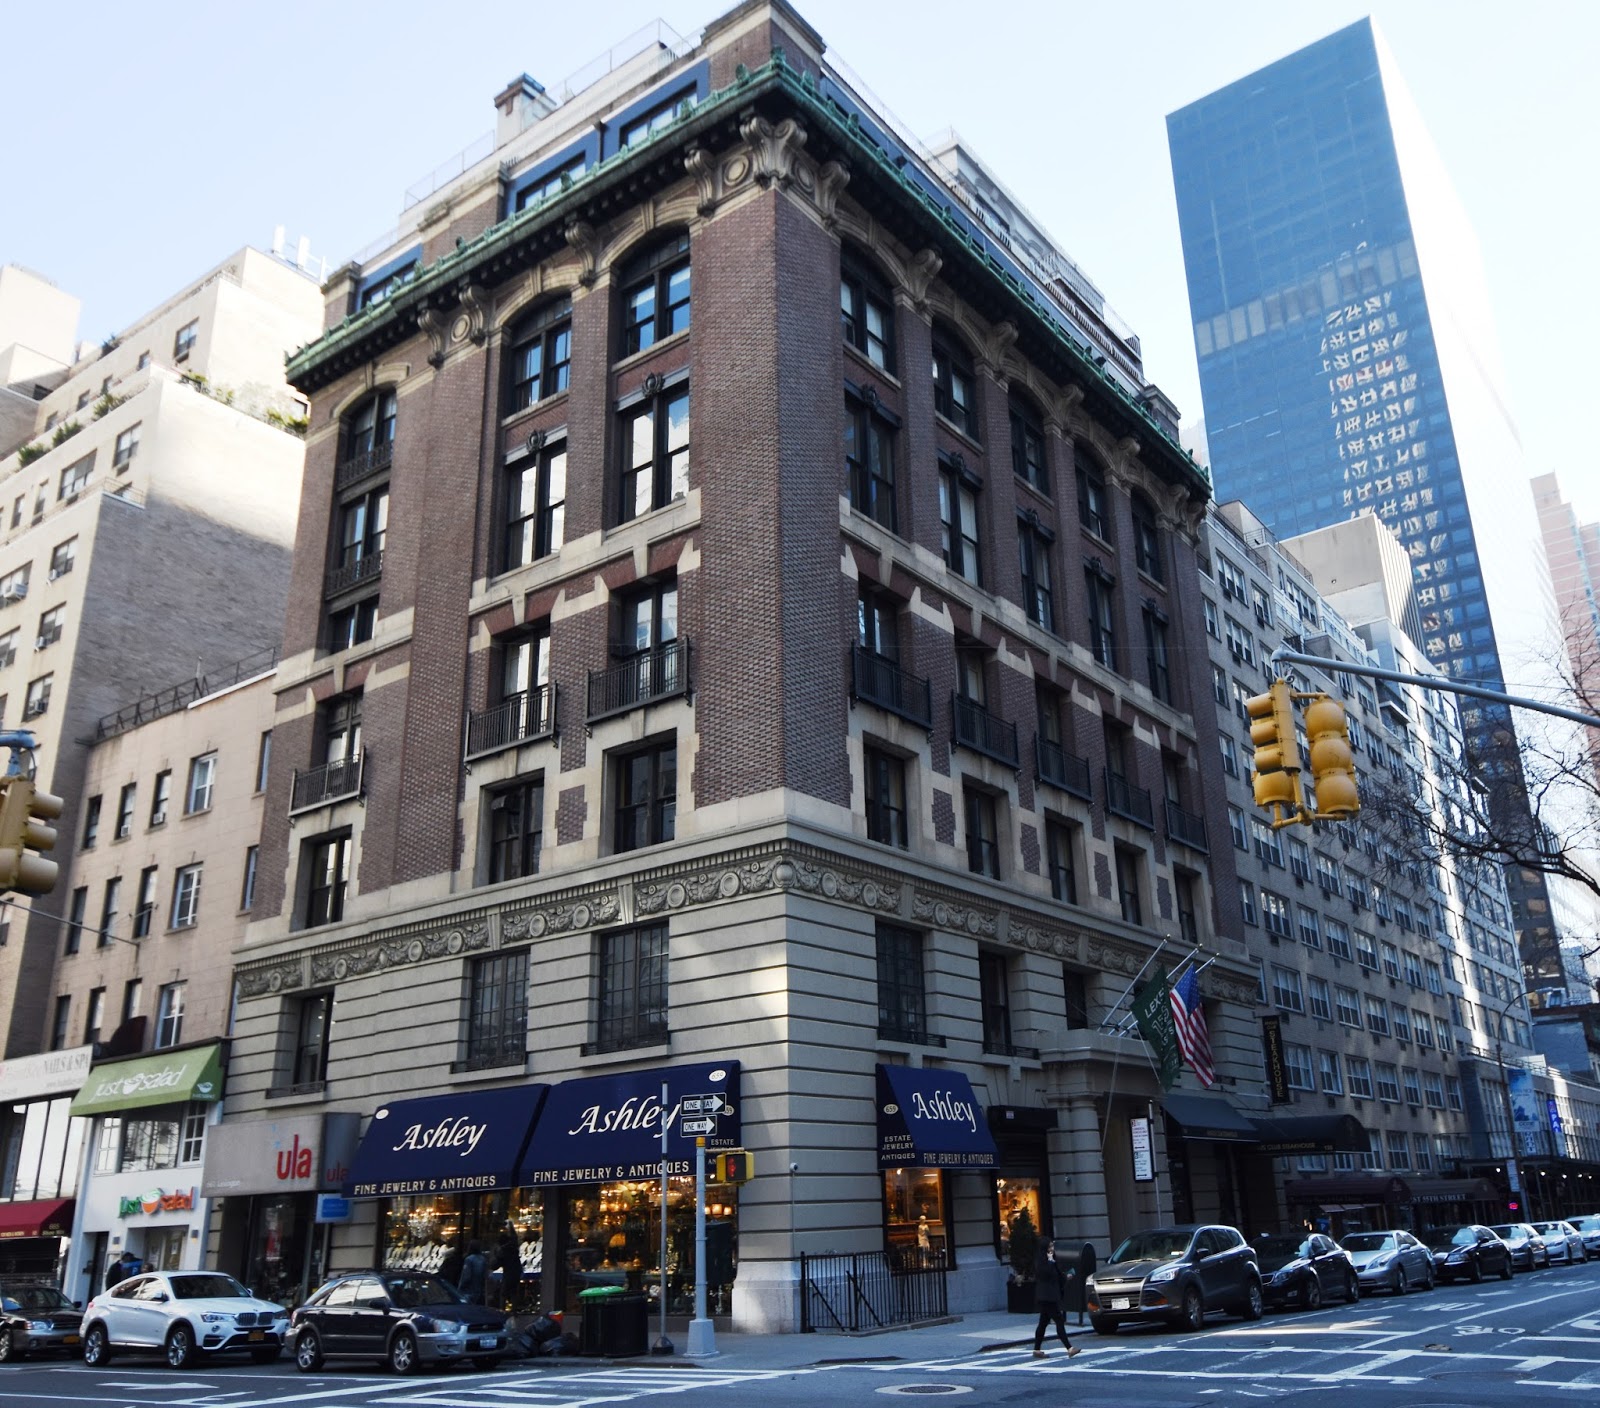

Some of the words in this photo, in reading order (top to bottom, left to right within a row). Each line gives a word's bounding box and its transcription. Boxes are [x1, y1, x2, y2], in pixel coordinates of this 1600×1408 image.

[1269, 1030, 1283, 1098] STEAKHOUSE
[139, 1064, 187, 1091] salad
[685, 1101, 698, 1109] ONE
[701, 1100, 714, 1108] AY
[885, 1105, 897, 1113] 659
[912, 1090, 977, 1132] Ashley
[568, 1095, 681, 1139] Ashley
[685, 1123, 695, 1131] ONE
[696, 1121, 707, 1130] WAY
[392, 1116, 487, 1156] Ashley
[711, 1138, 734, 1146] ESTATE
[884, 1134, 911, 1143] ESTATE
[882, 1142, 914, 1151] JEWELRY
[276, 1134, 312, 1181] ula
[881, 1152, 916, 1160] ANTIQUES
[923, 1152, 936, 1164] FINE
[938, 1153, 961, 1164] JEWELRY
[962, 1153, 967, 1164] &
[968, 1153, 994, 1165] ANTIQUES
[533, 1170, 559, 1183] FINE
[562, 1167, 612, 1181] JEWELRY
[616, 1166, 624, 1178] &
[629, 1160, 690, 1177] ANTIQUES
[354, 1184, 377, 1195] FINE
[380, 1180, 426, 1194] JEWELRY
[429, 1179, 437, 1190] &
[440, 1175, 497, 1189] ANTIQUES
[1439, 1193, 1466, 1202] STREET
